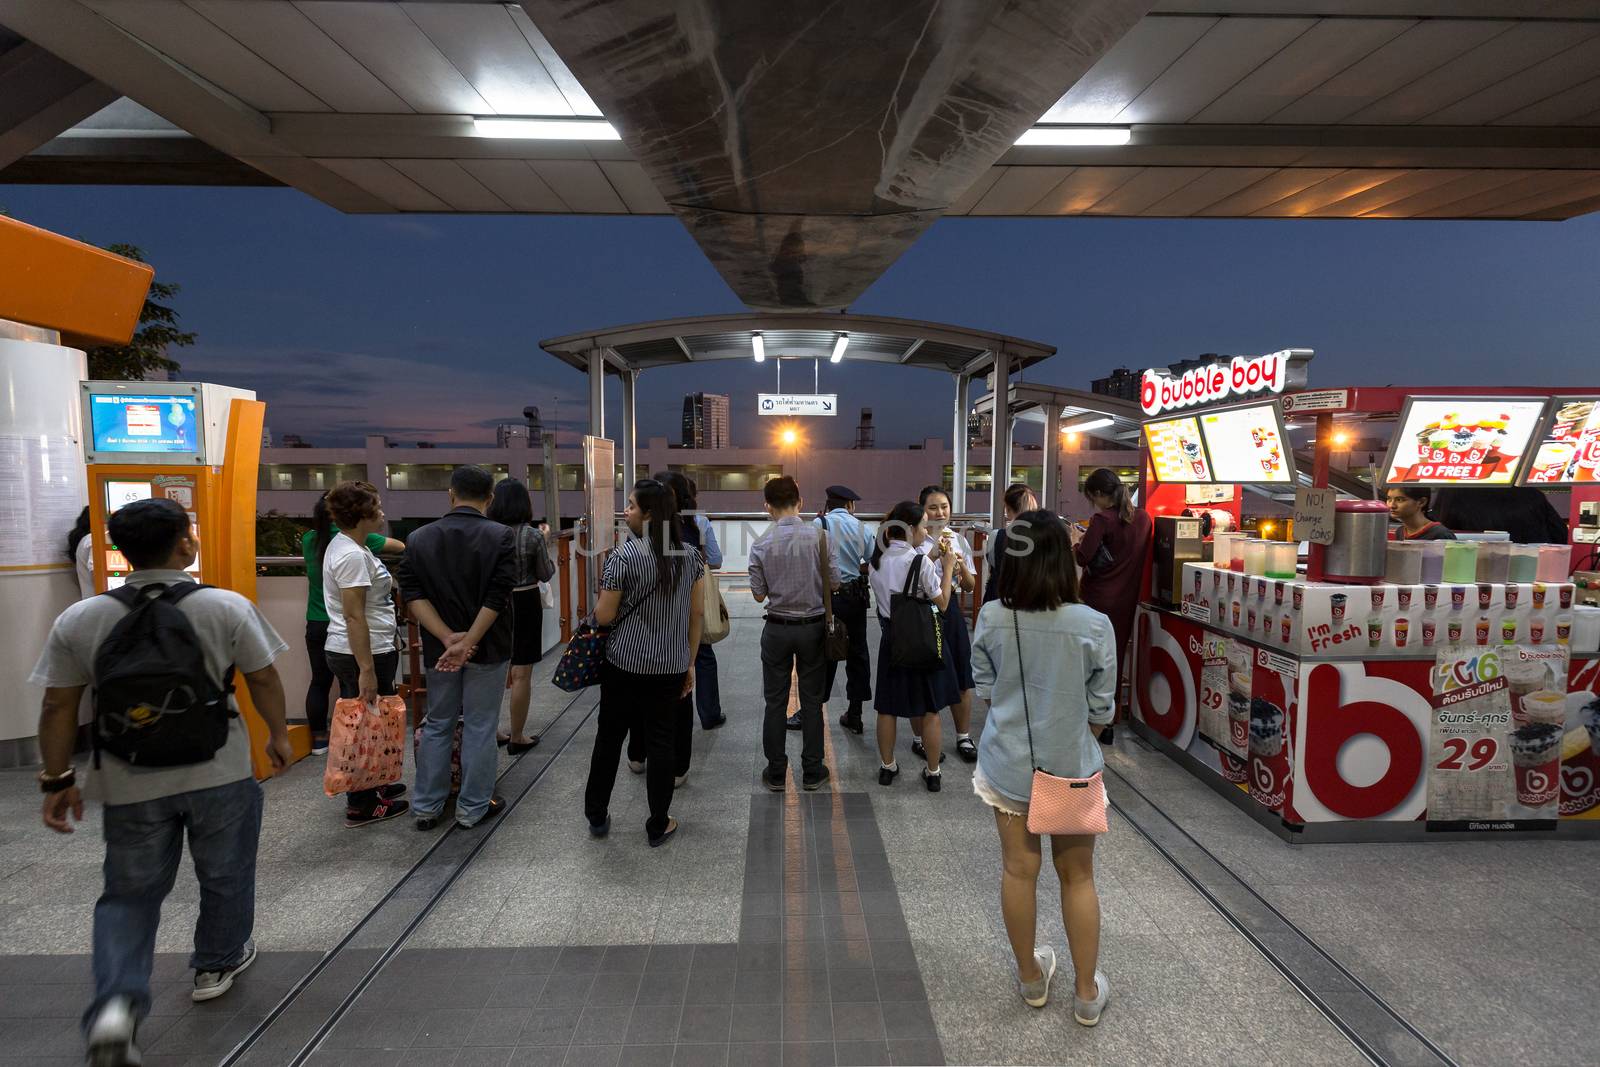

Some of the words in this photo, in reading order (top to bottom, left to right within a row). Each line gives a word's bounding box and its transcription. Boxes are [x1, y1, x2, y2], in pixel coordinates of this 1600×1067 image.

[1161, 369, 1225, 405] bubble
[1233, 356, 1278, 388] boy
[1417, 465, 1433, 476] 10
[1435, 465, 1472, 476] FREE
[1475, 465, 1482, 476] 1
[1306, 493, 1325, 509] NO!
[1307, 623, 1331, 639] I'm
[1311, 624, 1362, 653] Fresh
[1202, 687, 1223, 710] 29
[1442, 678, 1504, 705] ต้อนรับปีใหม่
[1438, 711, 1510, 727] จันทร์-ศุกร์
[1436, 738, 1498, 771] 29
